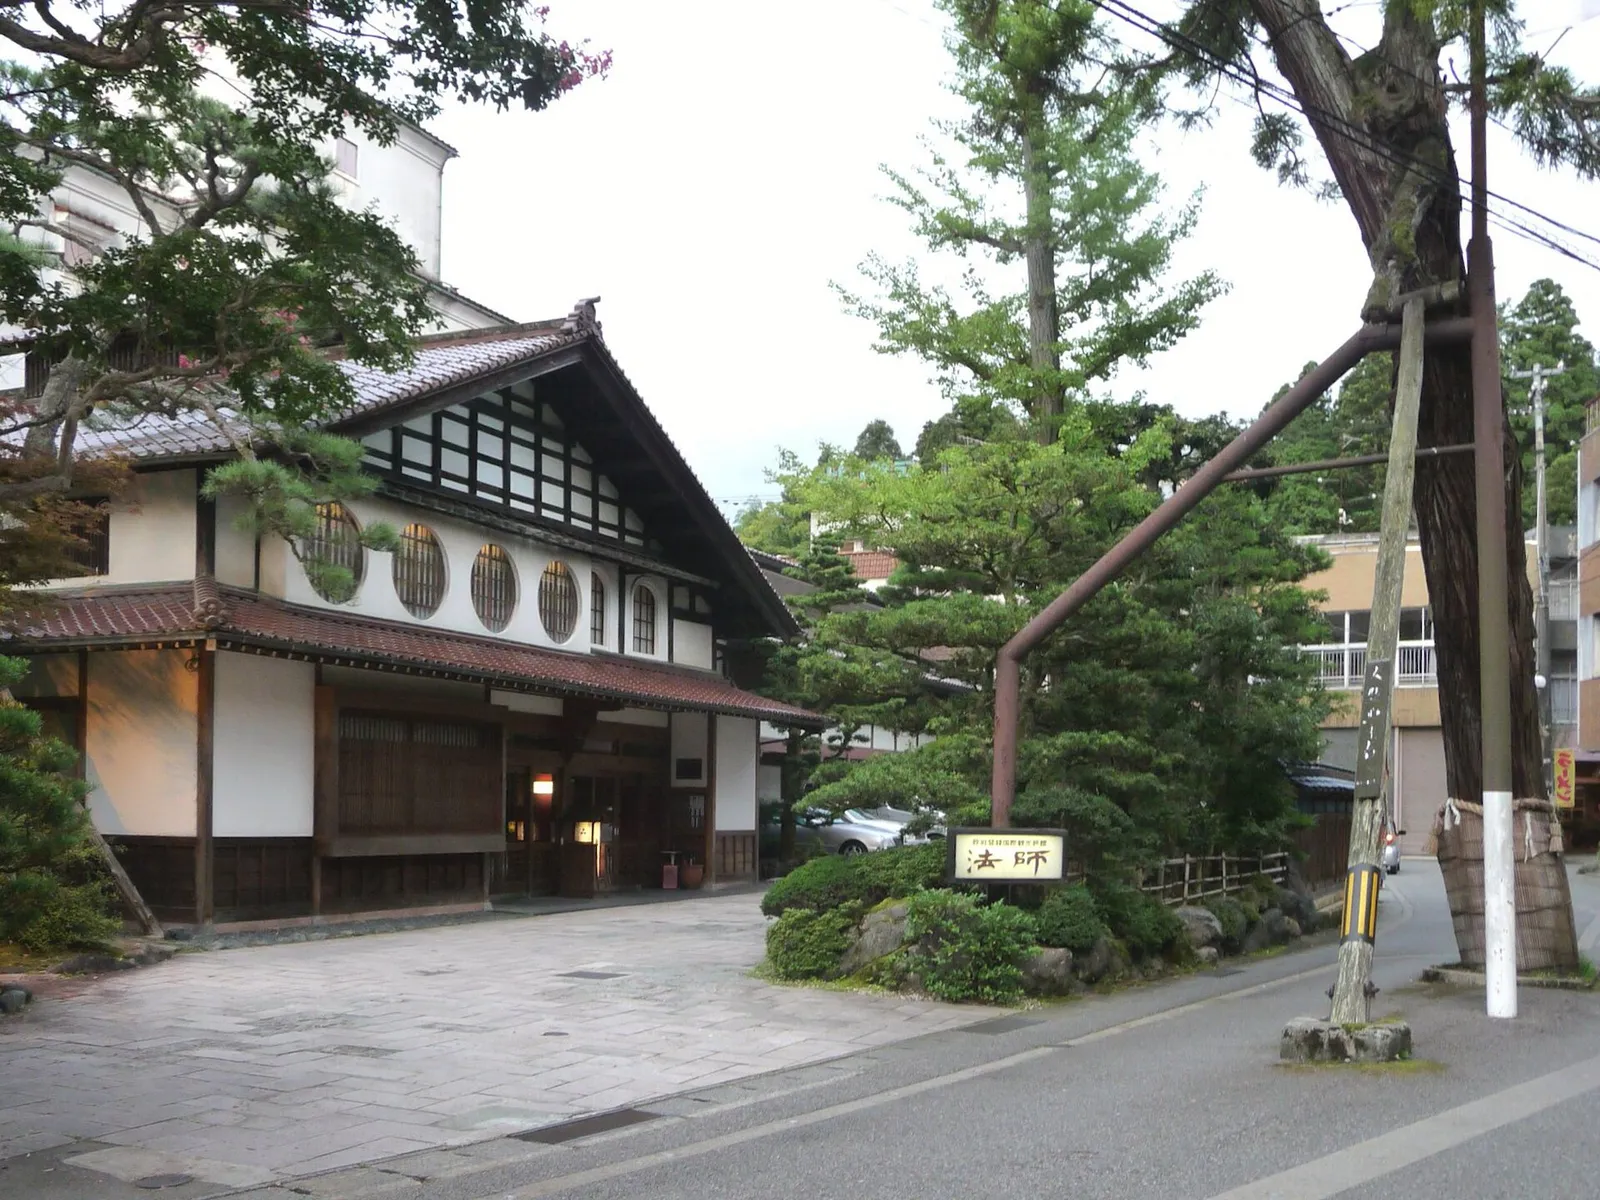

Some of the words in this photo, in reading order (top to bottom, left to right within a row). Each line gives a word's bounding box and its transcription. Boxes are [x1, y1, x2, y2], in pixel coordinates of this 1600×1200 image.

[1556, 752, 1572, 801] ラーメン
[967, 849, 1050, 876] 法師
